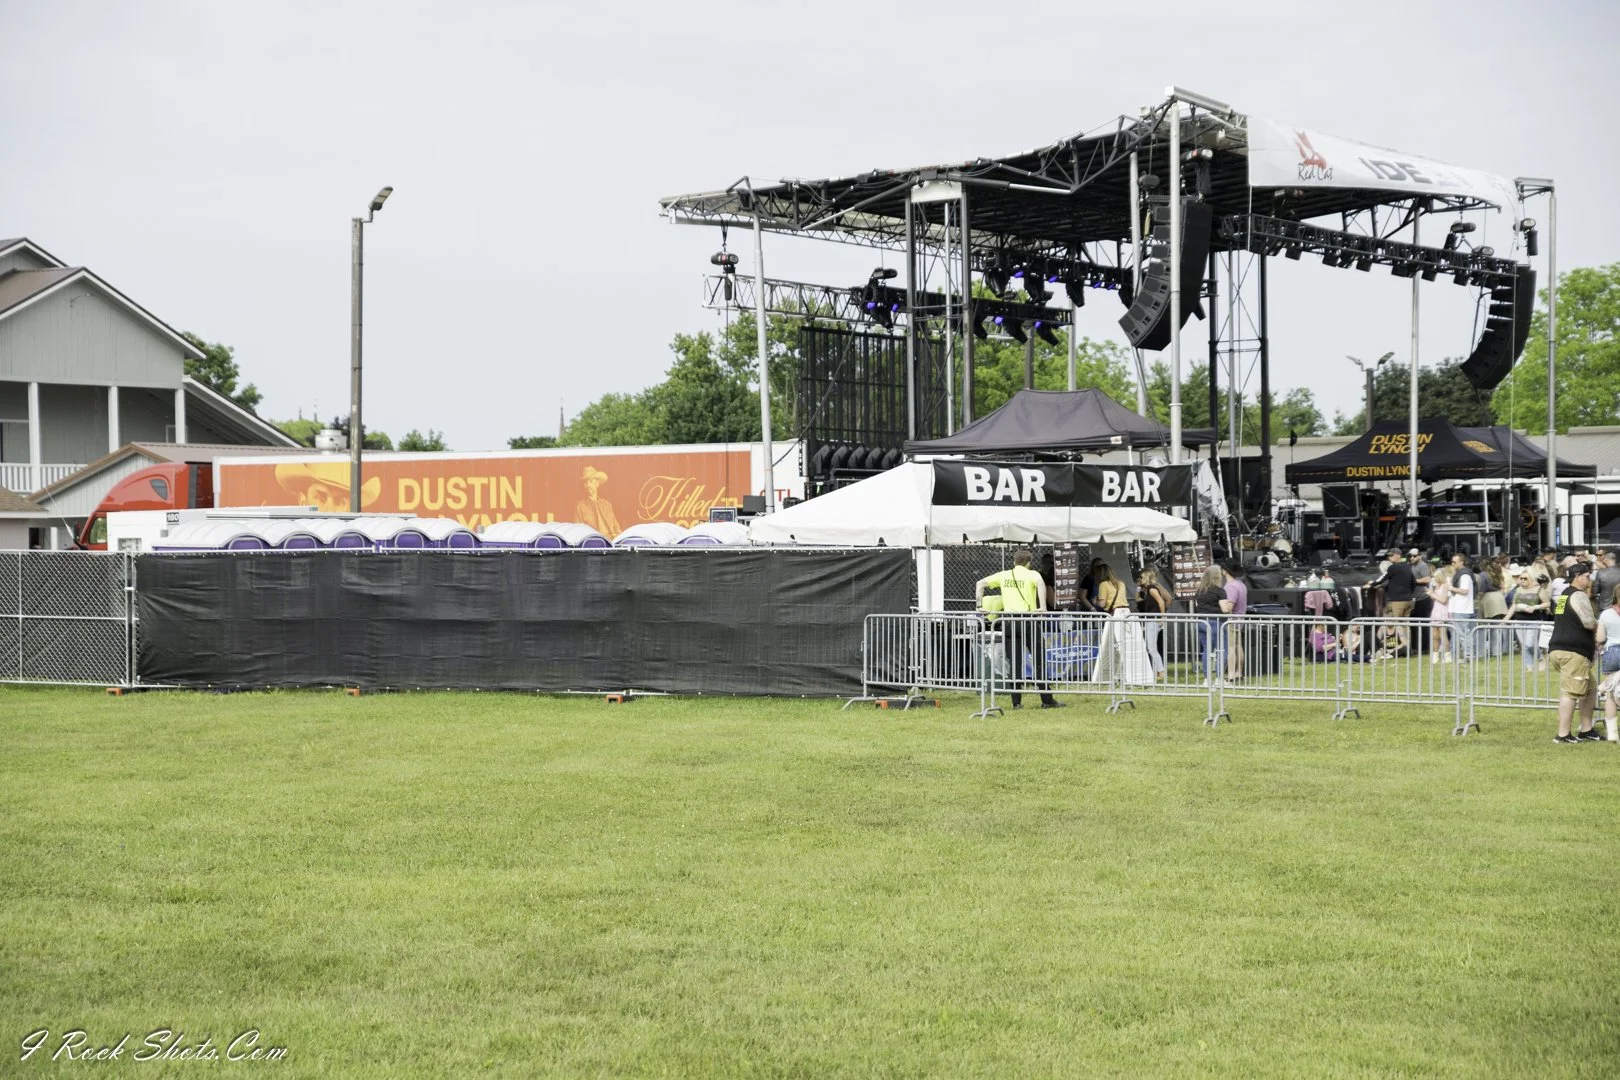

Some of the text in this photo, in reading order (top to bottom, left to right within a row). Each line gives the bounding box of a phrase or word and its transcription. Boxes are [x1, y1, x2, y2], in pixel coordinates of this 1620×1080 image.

[1297, 162, 1316, 181] Red
[963, 466, 1047, 503] BAR
[1102, 470, 1162, 503] BAR
[1347, 466, 1384, 477] DUSTIN
[398, 475, 523, 511] DUSTIN
[637, 474, 726, 521] Killed
